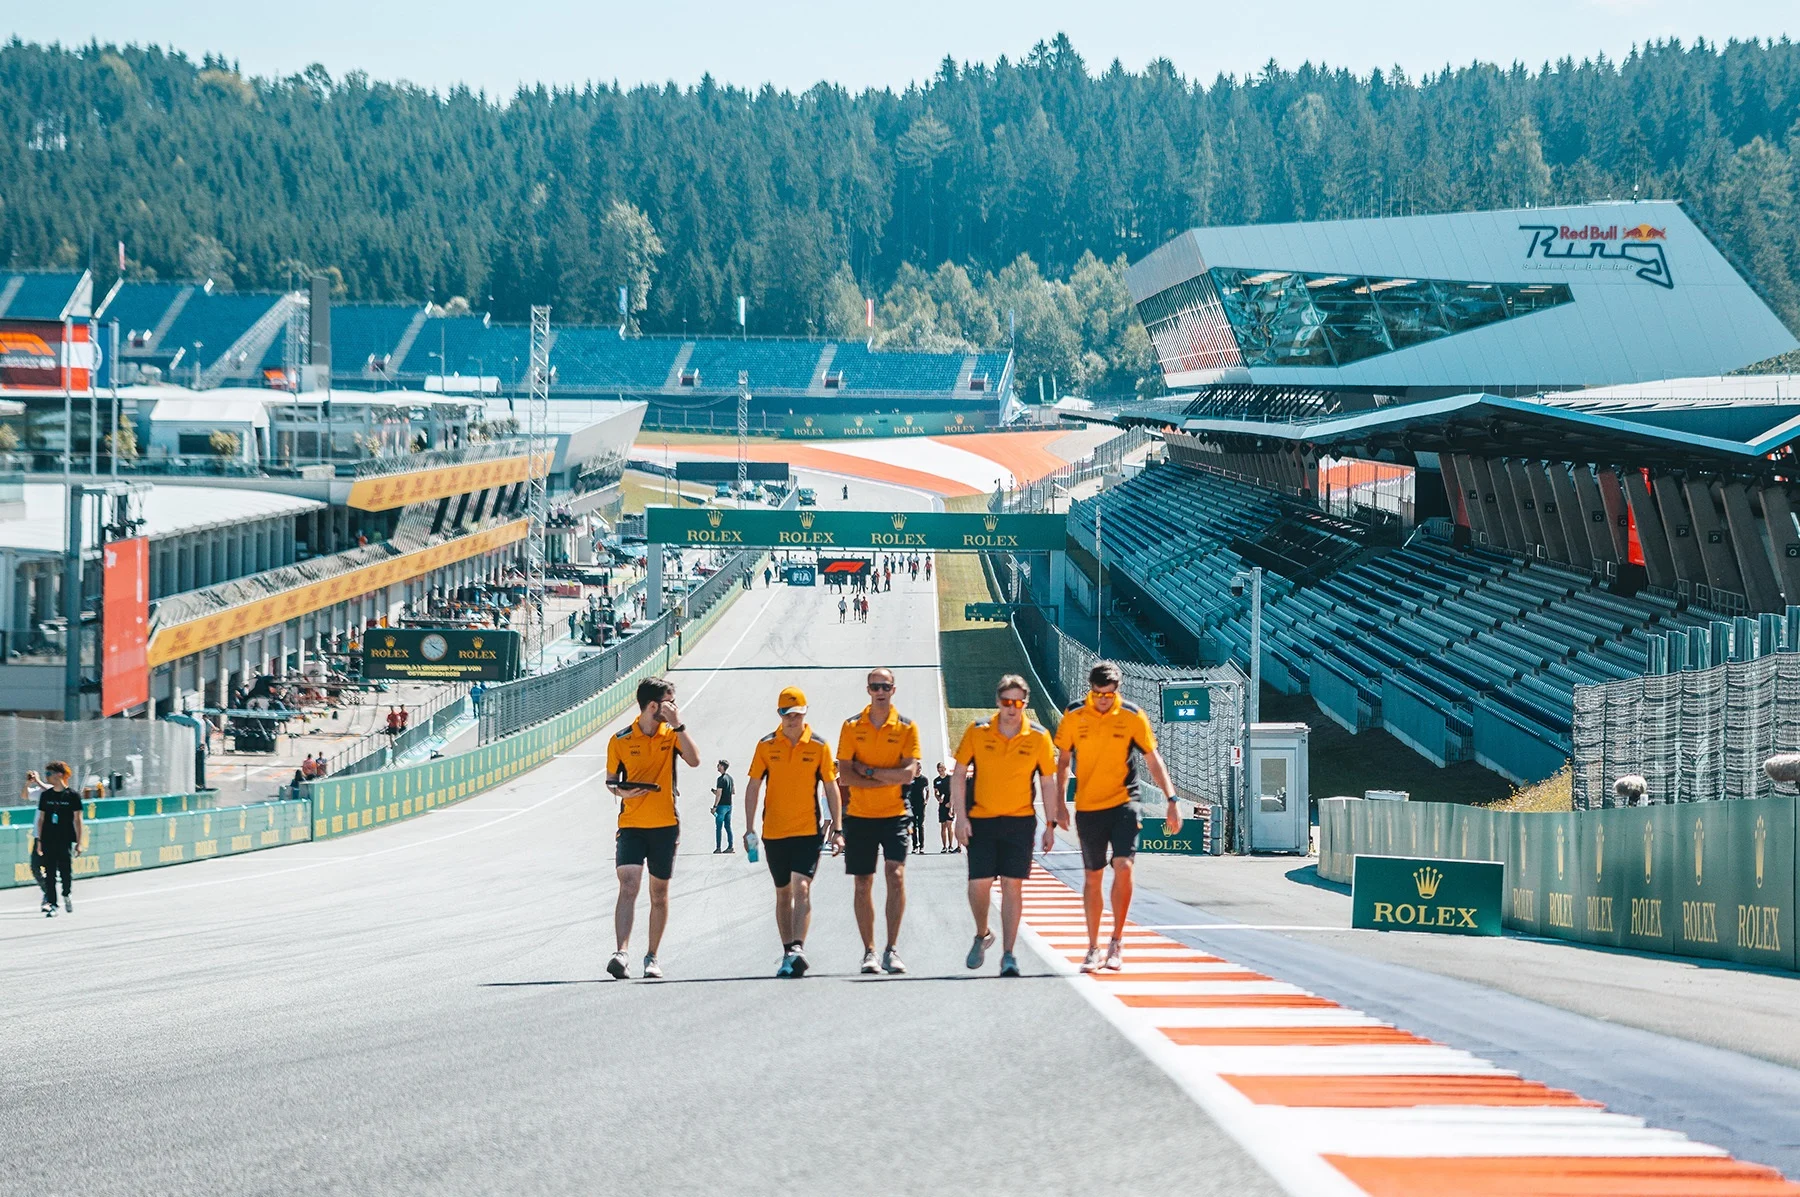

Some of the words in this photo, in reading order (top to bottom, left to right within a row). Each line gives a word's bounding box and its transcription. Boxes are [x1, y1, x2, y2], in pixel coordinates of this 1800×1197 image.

[1560, 225, 1588, 240] Red
[1590, 225, 1617, 240] Bull
[1519, 226, 1674, 290] Ring
[793, 427, 825, 436] ROLEX
[843, 427, 875, 435] ROLEX
[894, 425, 925, 434] ROLEX
[944, 424, 975, 433] ROLEX
[687, 530, 743, 543] ROLEX
[779, 531, 835, 544] ROLEX
[870, 533, 927, 545] ROLEX
[963, 535, 1019, 546] ROLEX
[792, 572, 810, 582] FIA
[371, 648, 410, 658] ROLEX
[458, 650, 497, 659] ROLEX
[1173, 699, 1199, 707] ROLEX
[1141, 839, 1192, 850] ROLEX
[1513, 887, 1534, 922] ROLEX
[1549, 892, 1574, 928] ROLEX
[1373, 902, 1478, 929] ROLEX
[1587, 896, 1614, 932] ROLEX
[1630, 898, 1663, 938] ROLEX
[1683, 901, 1718, 943] ROLEX
[1738, 905, 1781, 951] ROLEX
